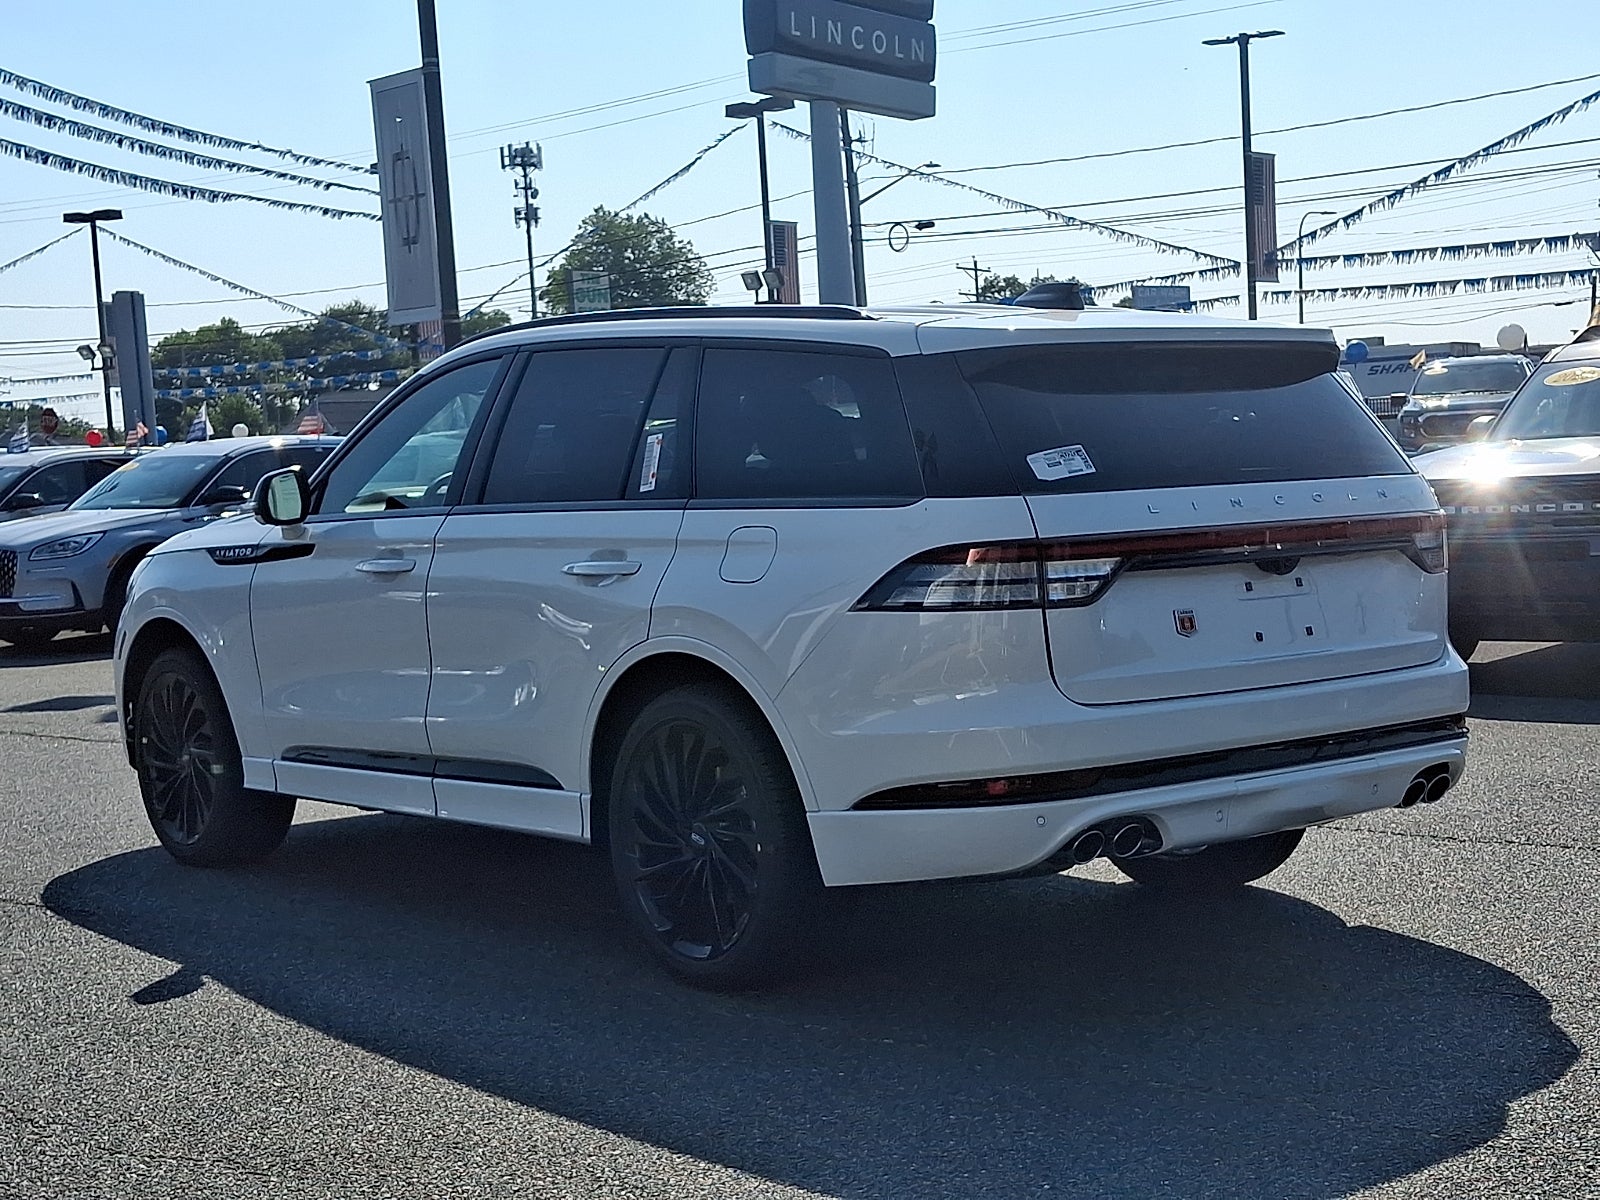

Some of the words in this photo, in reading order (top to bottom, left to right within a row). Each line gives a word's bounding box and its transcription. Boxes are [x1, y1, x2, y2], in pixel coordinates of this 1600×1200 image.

[790, 11, 925, 62] LINCOLN
[1147, 488, 1388, 514] LINCOLN
[215, 547, 252, 557] AVIATOR
